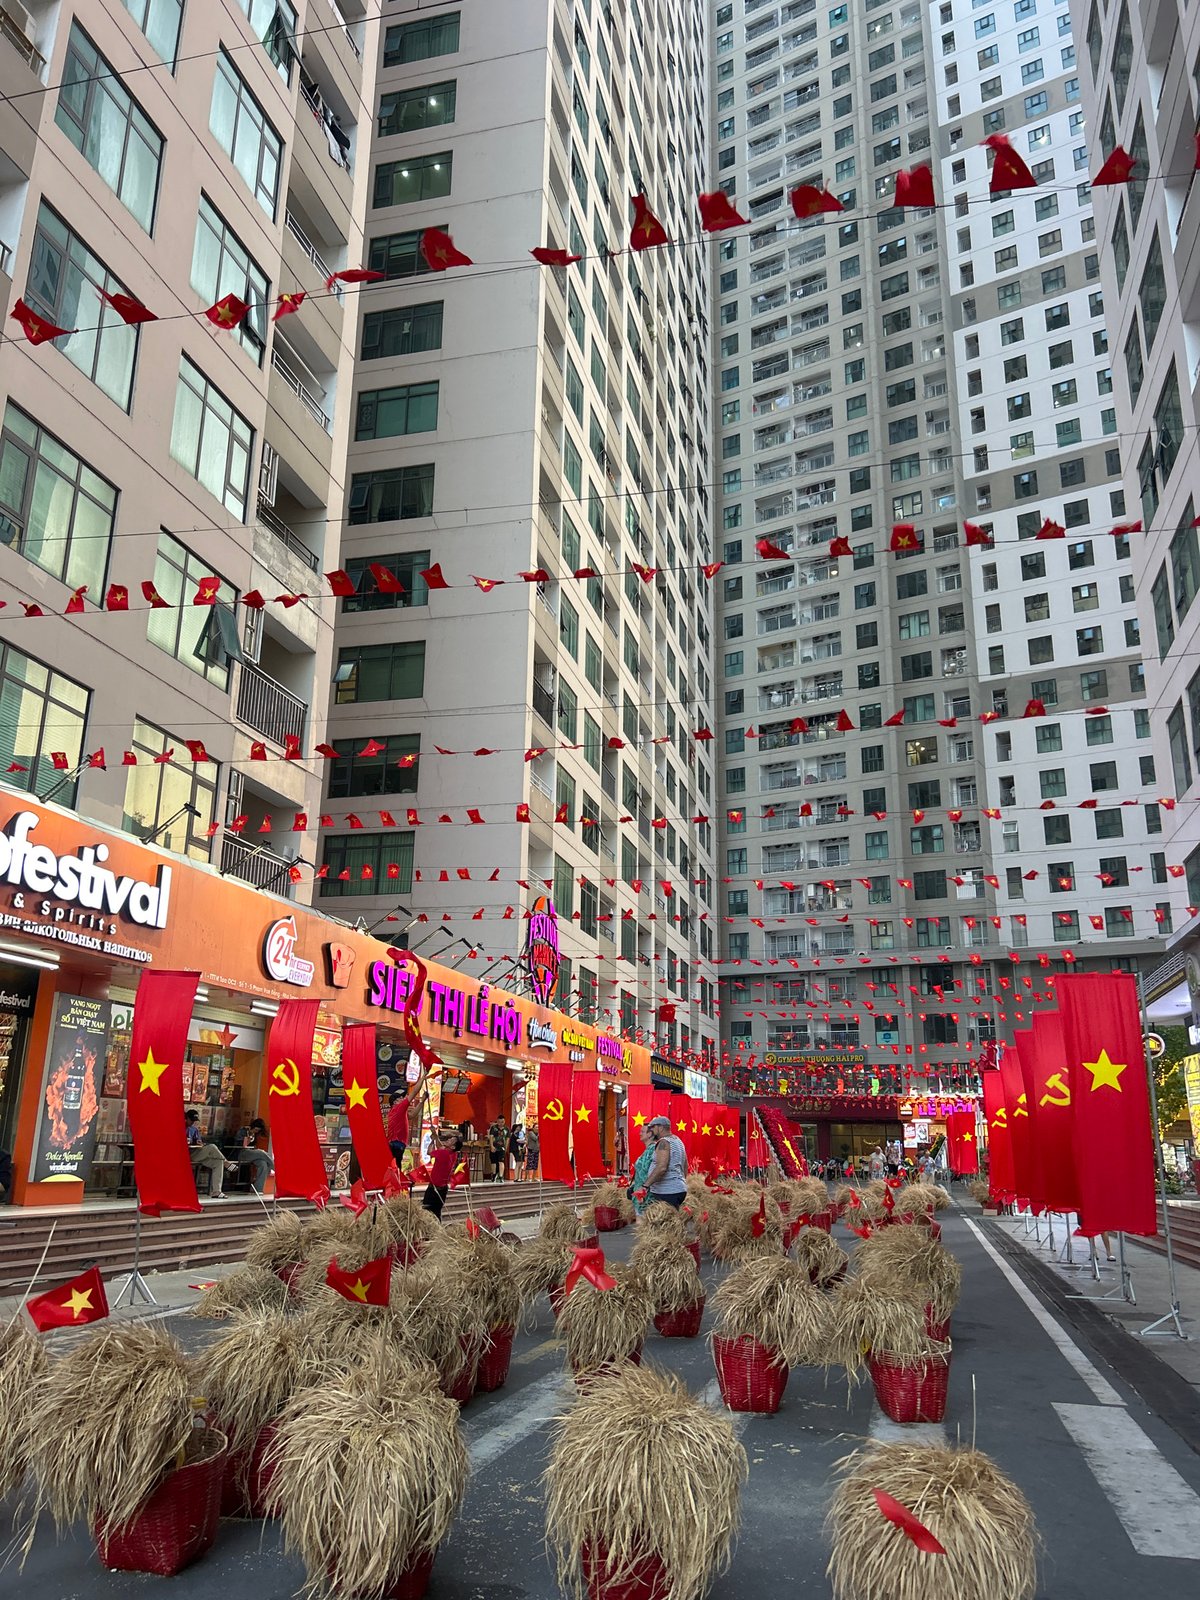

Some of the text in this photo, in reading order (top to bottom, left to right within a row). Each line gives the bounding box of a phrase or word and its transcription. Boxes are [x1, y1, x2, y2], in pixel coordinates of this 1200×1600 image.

[13, 892, 117, 935] & Spirits
[23, 920, 102, 950] алкогольных
[103, 940, 153, 962] напитков
[272, 935, 291, 966] 24
[61, 1013, 71, 1024] SỐ
[91, 1020, 105, 1029] NAM
[431, 981, 465, 1037] THỊ
[470, 985, 490, 1036] LỄ
[494, 998, 522, 1050] HỘI
[598, 1035, 623, 1061] FESTIVAL
[850, 1054, 864, 1062] PRO
